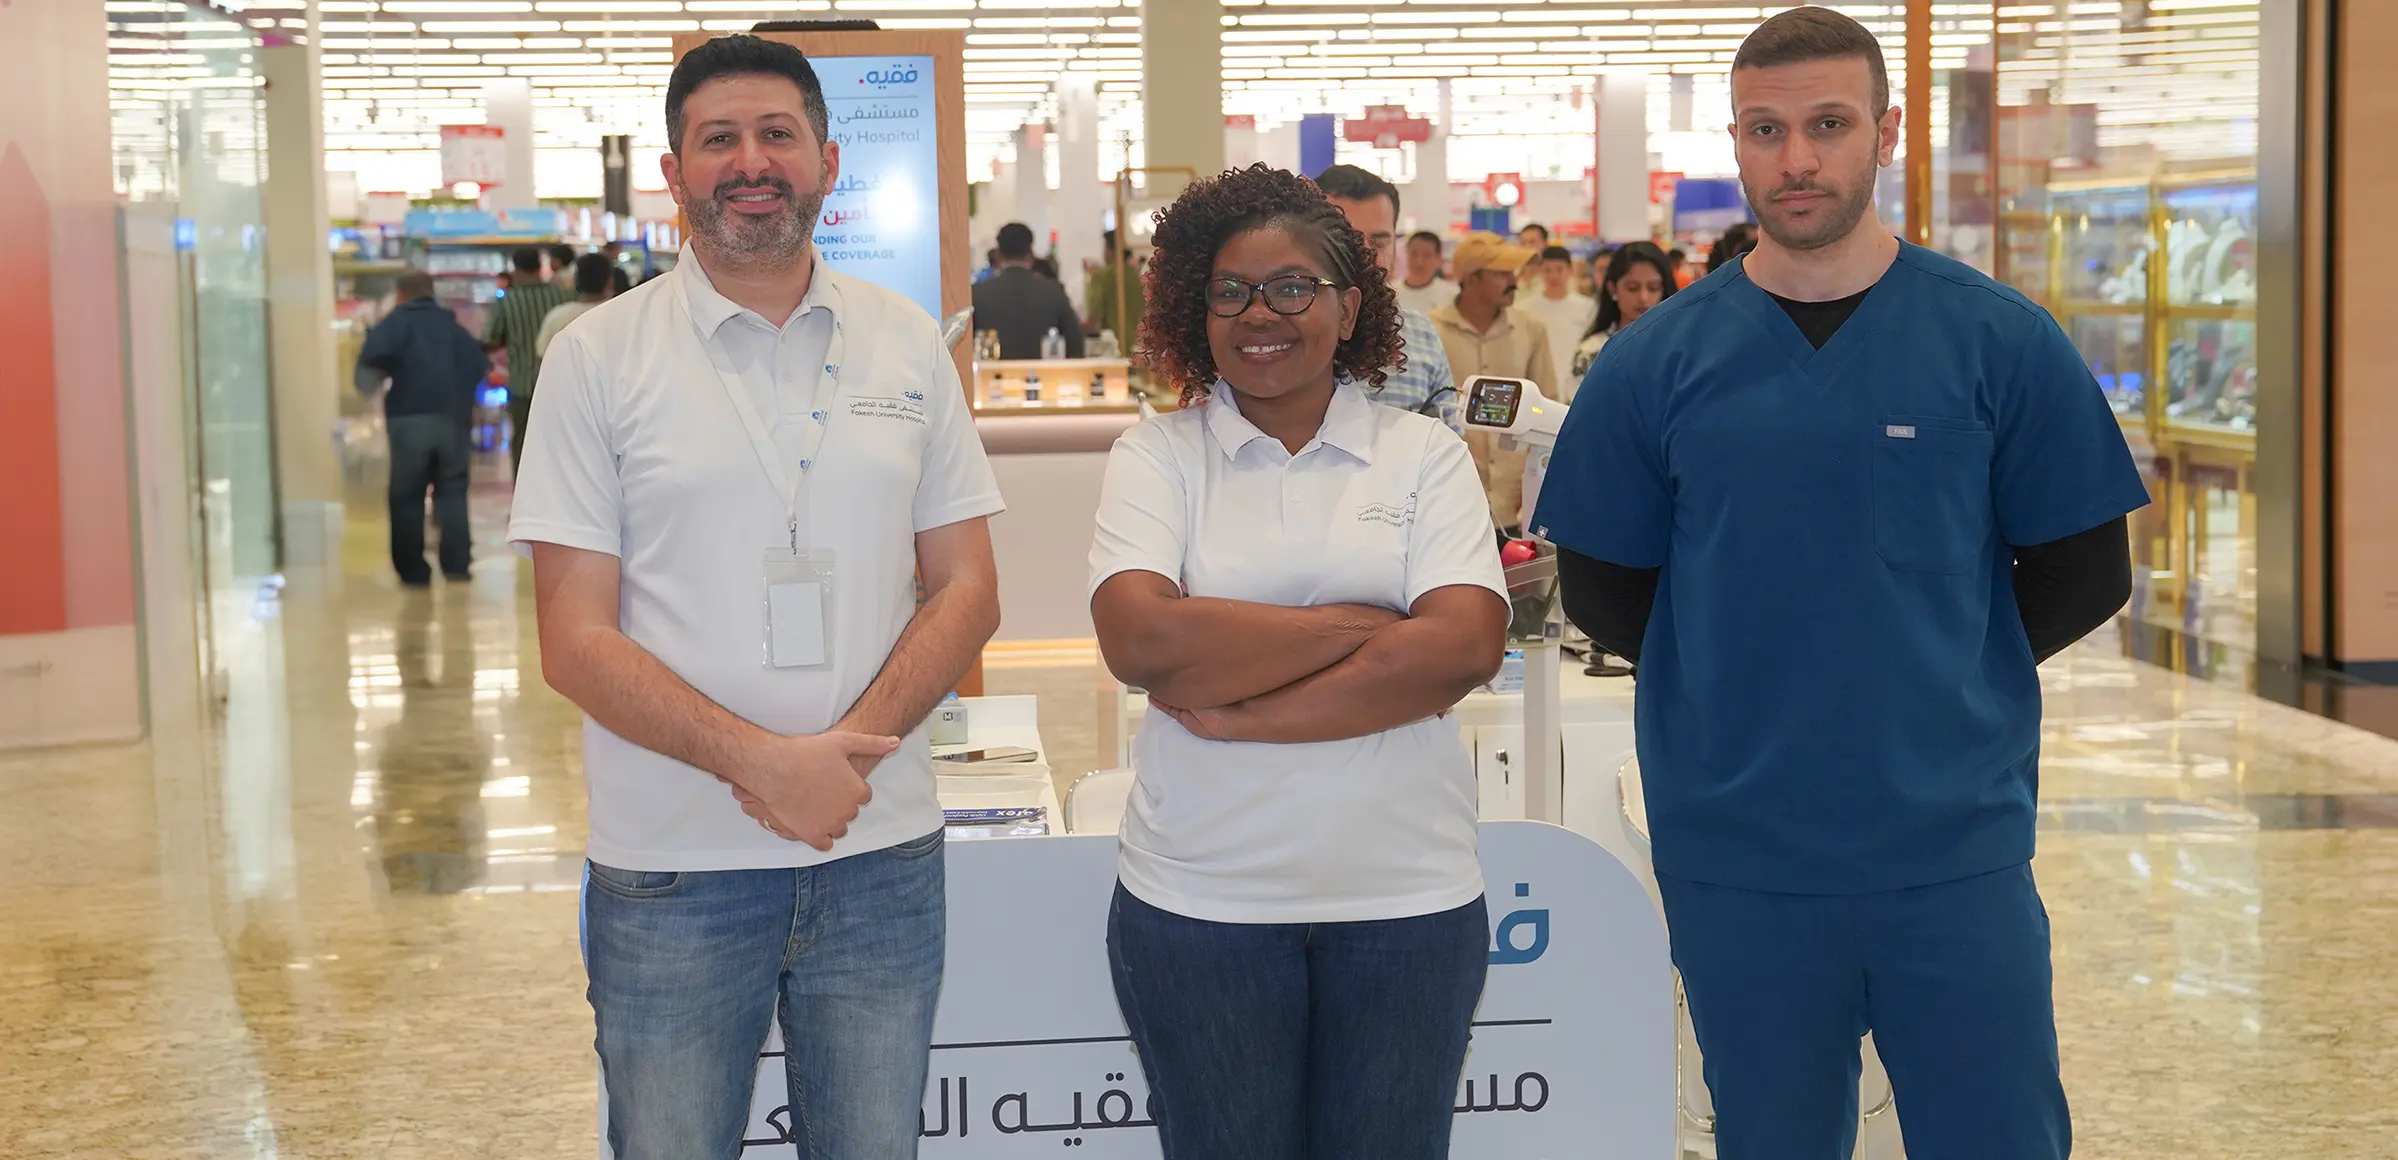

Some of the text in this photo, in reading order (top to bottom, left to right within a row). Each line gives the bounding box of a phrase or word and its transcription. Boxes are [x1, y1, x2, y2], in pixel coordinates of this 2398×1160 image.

[837, 103, 919, 125] مستشفى
[857, 130, 920, 145] Hospital
[812, 235, 848, 245] NDING
[832, 249, 897, 260] COVERAGE
[875, 411, 905, 420] University
